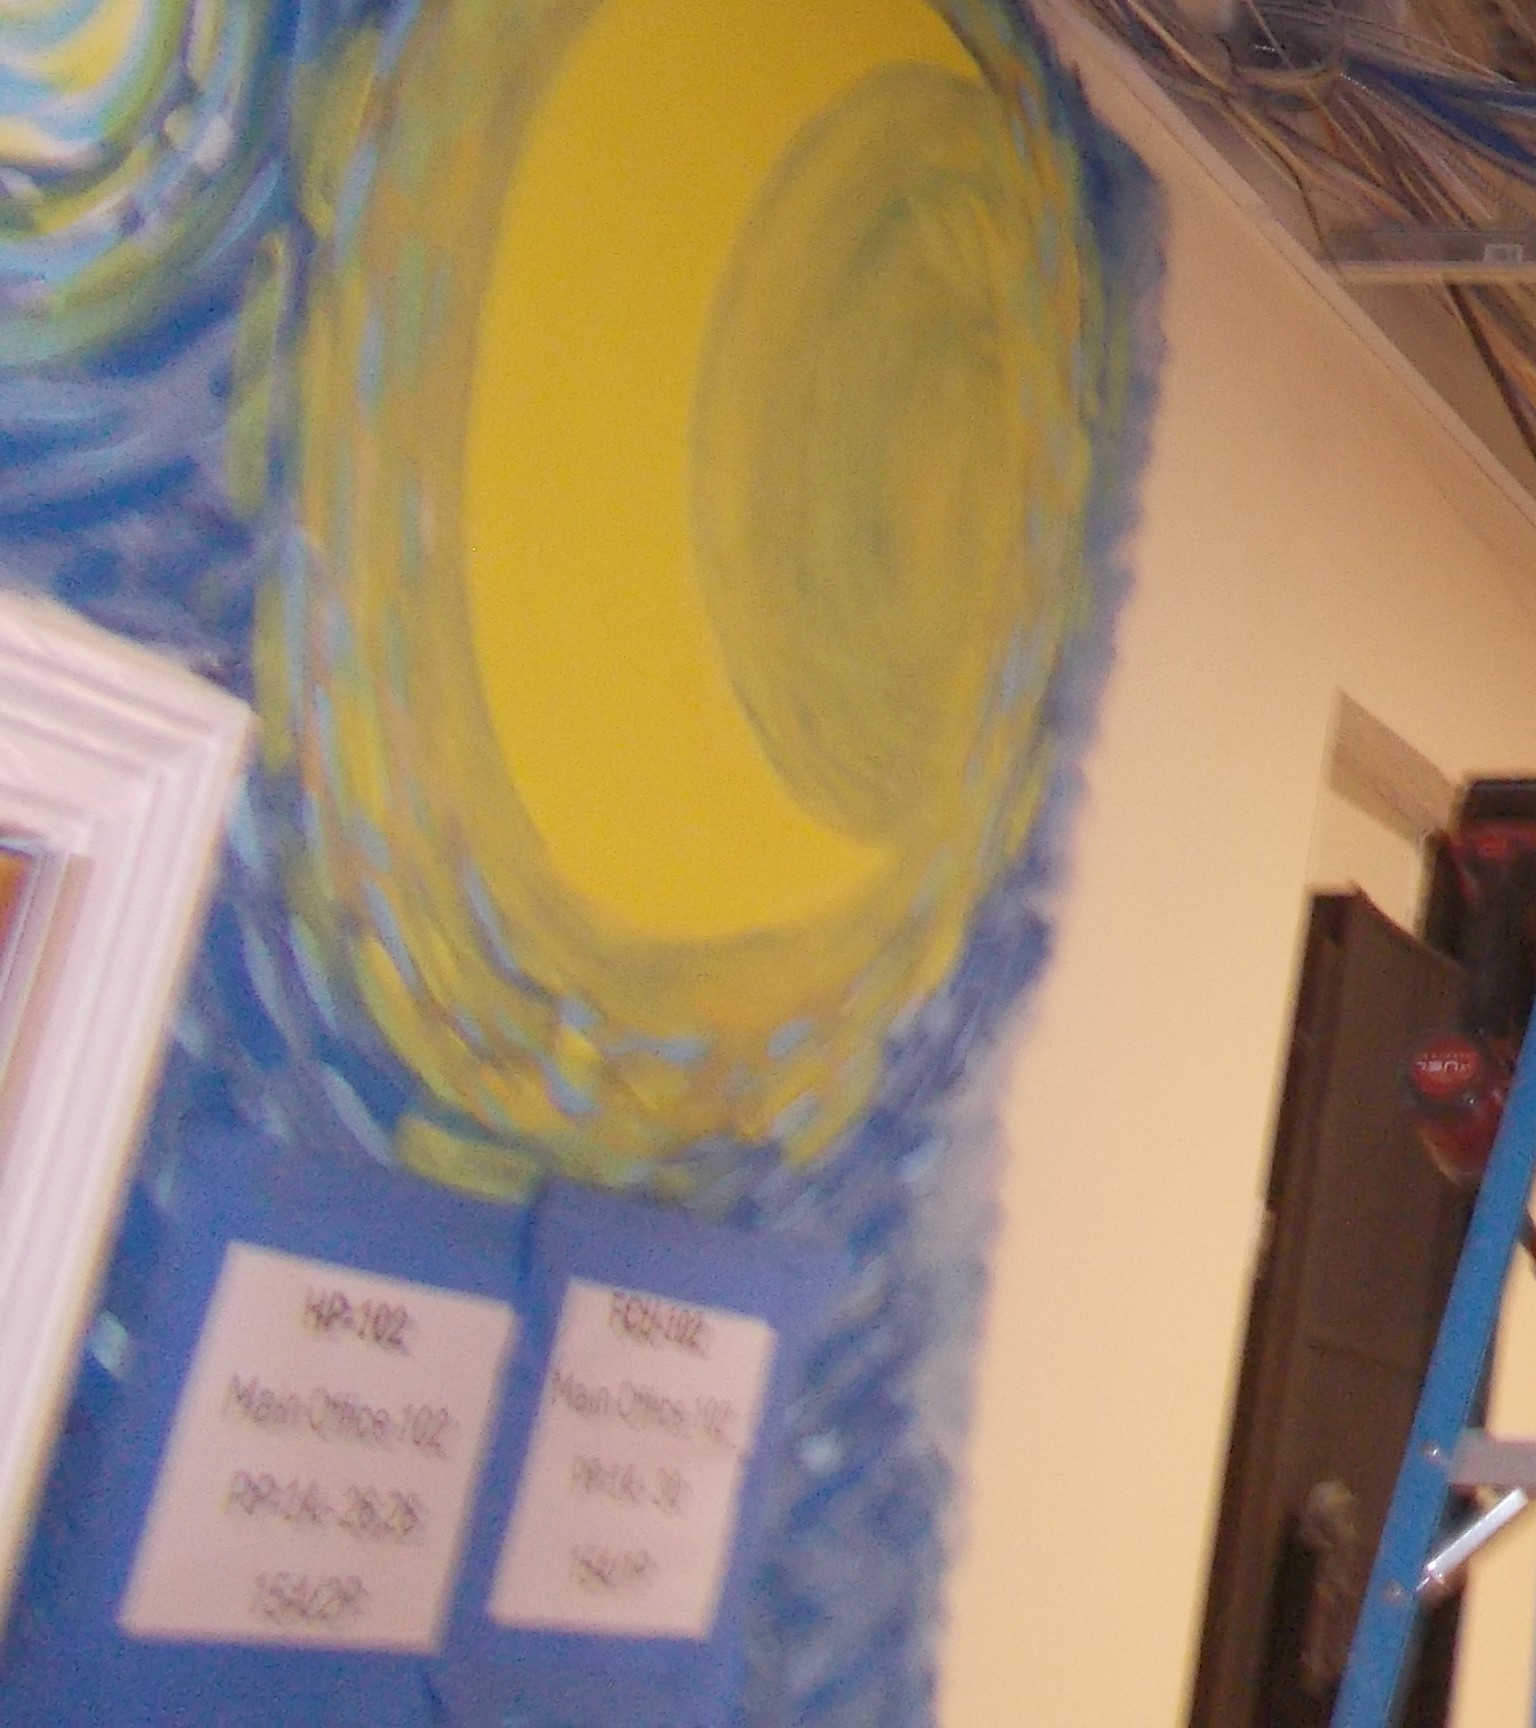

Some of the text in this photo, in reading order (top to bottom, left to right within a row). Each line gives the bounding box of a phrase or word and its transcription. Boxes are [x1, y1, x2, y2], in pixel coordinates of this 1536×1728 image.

[302, 1286, 411, 1352] HP-102
[226, 1374, 460, 1459] Main Office 102
[552, 1371, 612, 1420] Main
[615, 1381, 695, 1437] Office
